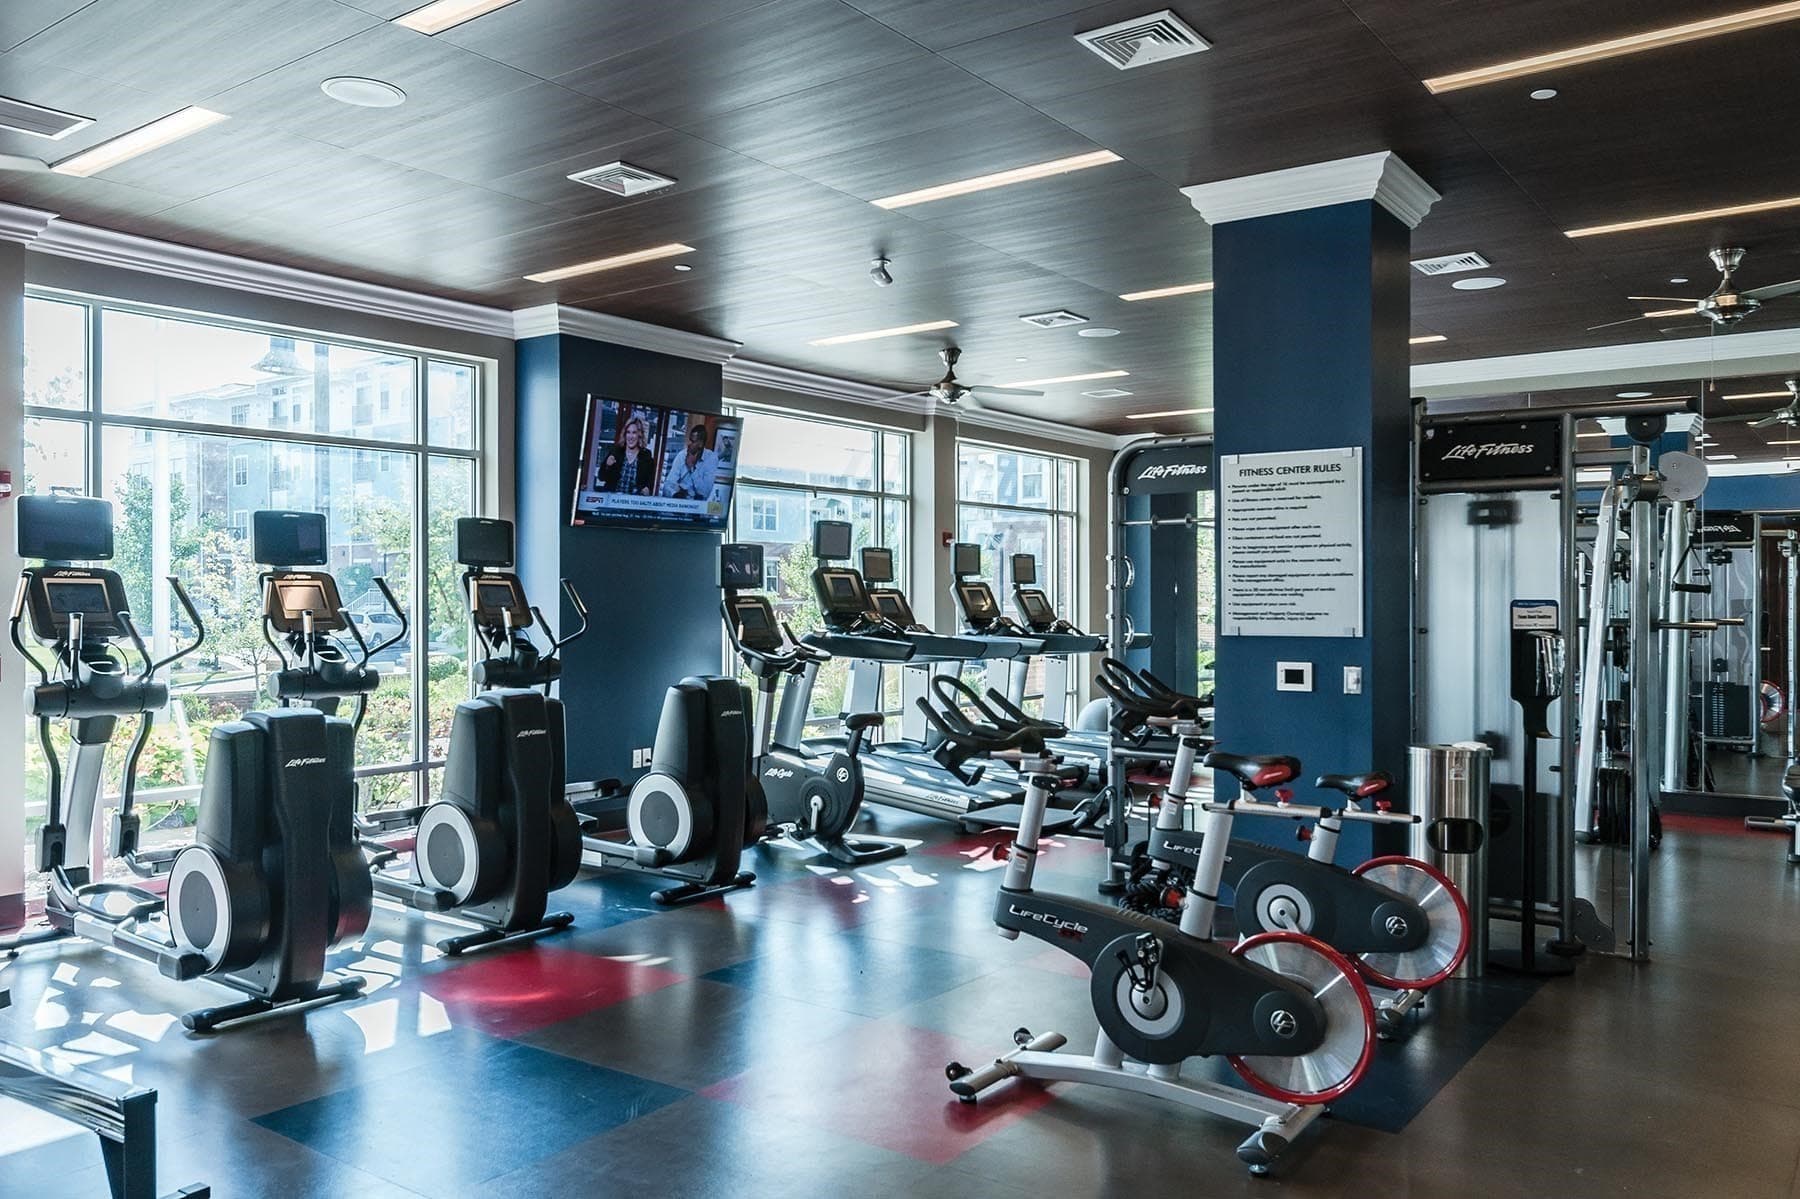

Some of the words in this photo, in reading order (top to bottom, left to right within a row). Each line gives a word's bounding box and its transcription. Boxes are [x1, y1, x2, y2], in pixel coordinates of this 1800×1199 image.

[1441, 444, 1477, 460] Life
[1474, 443, 1534, 459] Fitness
[1137, 465, 1164, 480] Life
[1162, 464, 1208, 478] Fitness
[1239, 467, 1274, 477] FITNESS
[1276, 465, 1311, 475] CENTER
[1314, 463, 1342, 472] RULES
